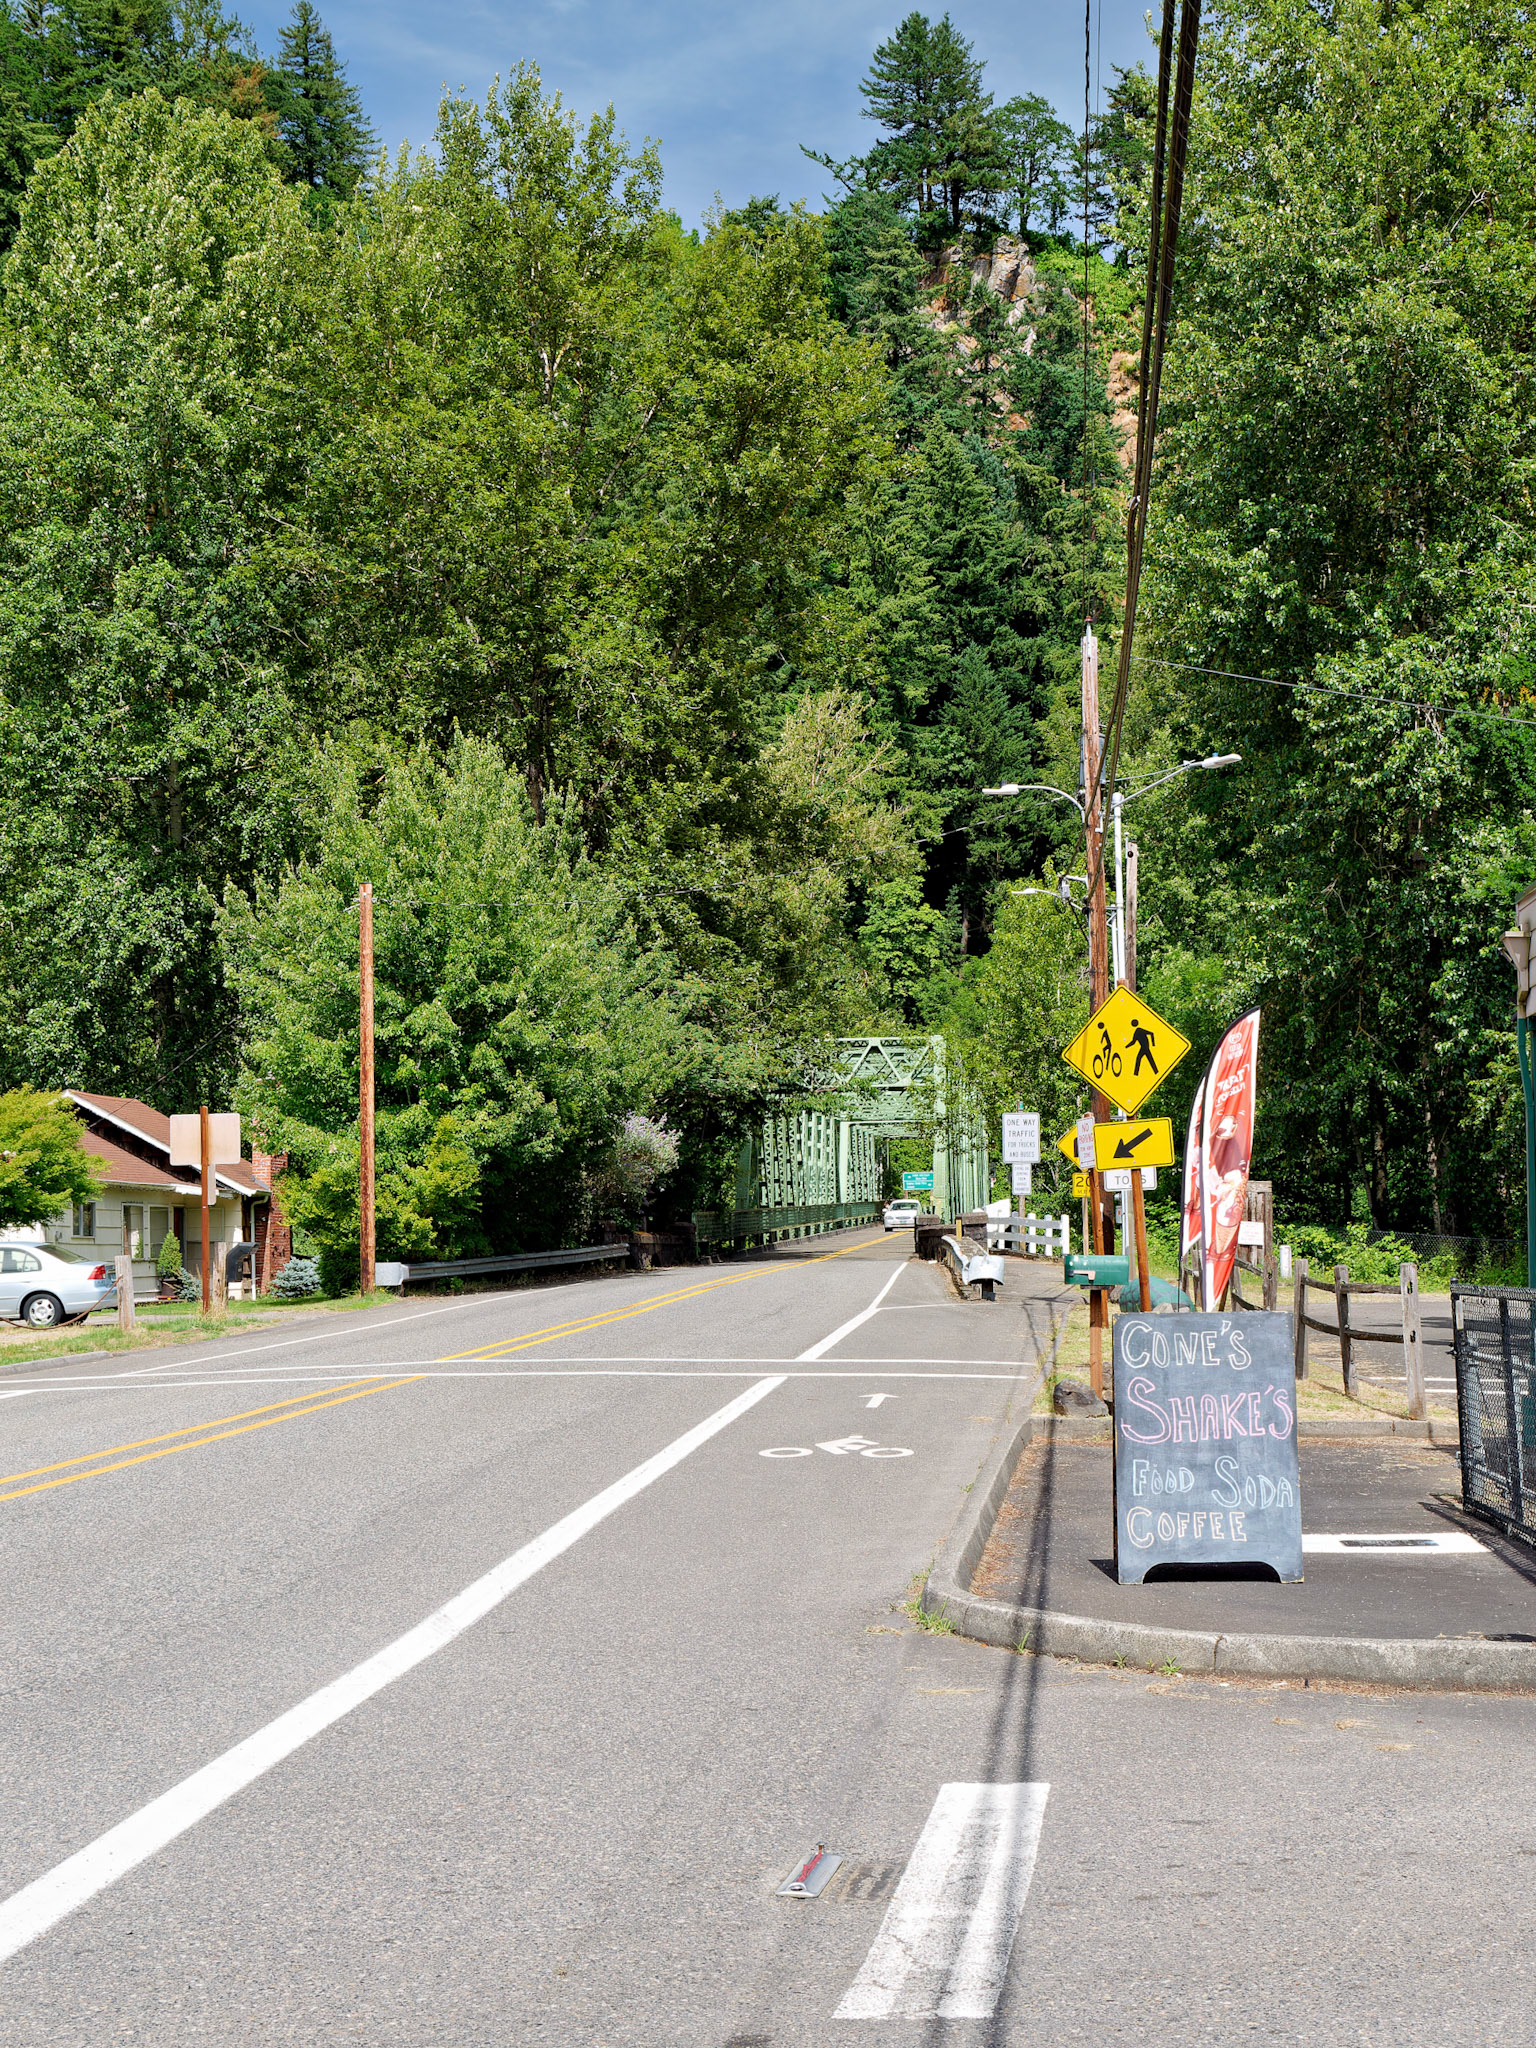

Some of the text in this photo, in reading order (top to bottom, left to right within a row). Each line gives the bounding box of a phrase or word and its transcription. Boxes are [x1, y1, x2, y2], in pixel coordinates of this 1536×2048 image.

[1006, 1118, 1036, 1126] ONE WAY
[1008, 1130, 1035, 1138] TRAFFIC
[1081, 1122, 1090, 1133] NO
[1114, 1174, 1147, 1185] TOS
[1121, 1320, 1252, 1370] CONE'S
[1121, 1376, 1294, 1444] SHAKE'S
[1132, 1455, 1294, 1509] FOOD SODA
[1126, 1506, 1248, 1549] COFFEE
